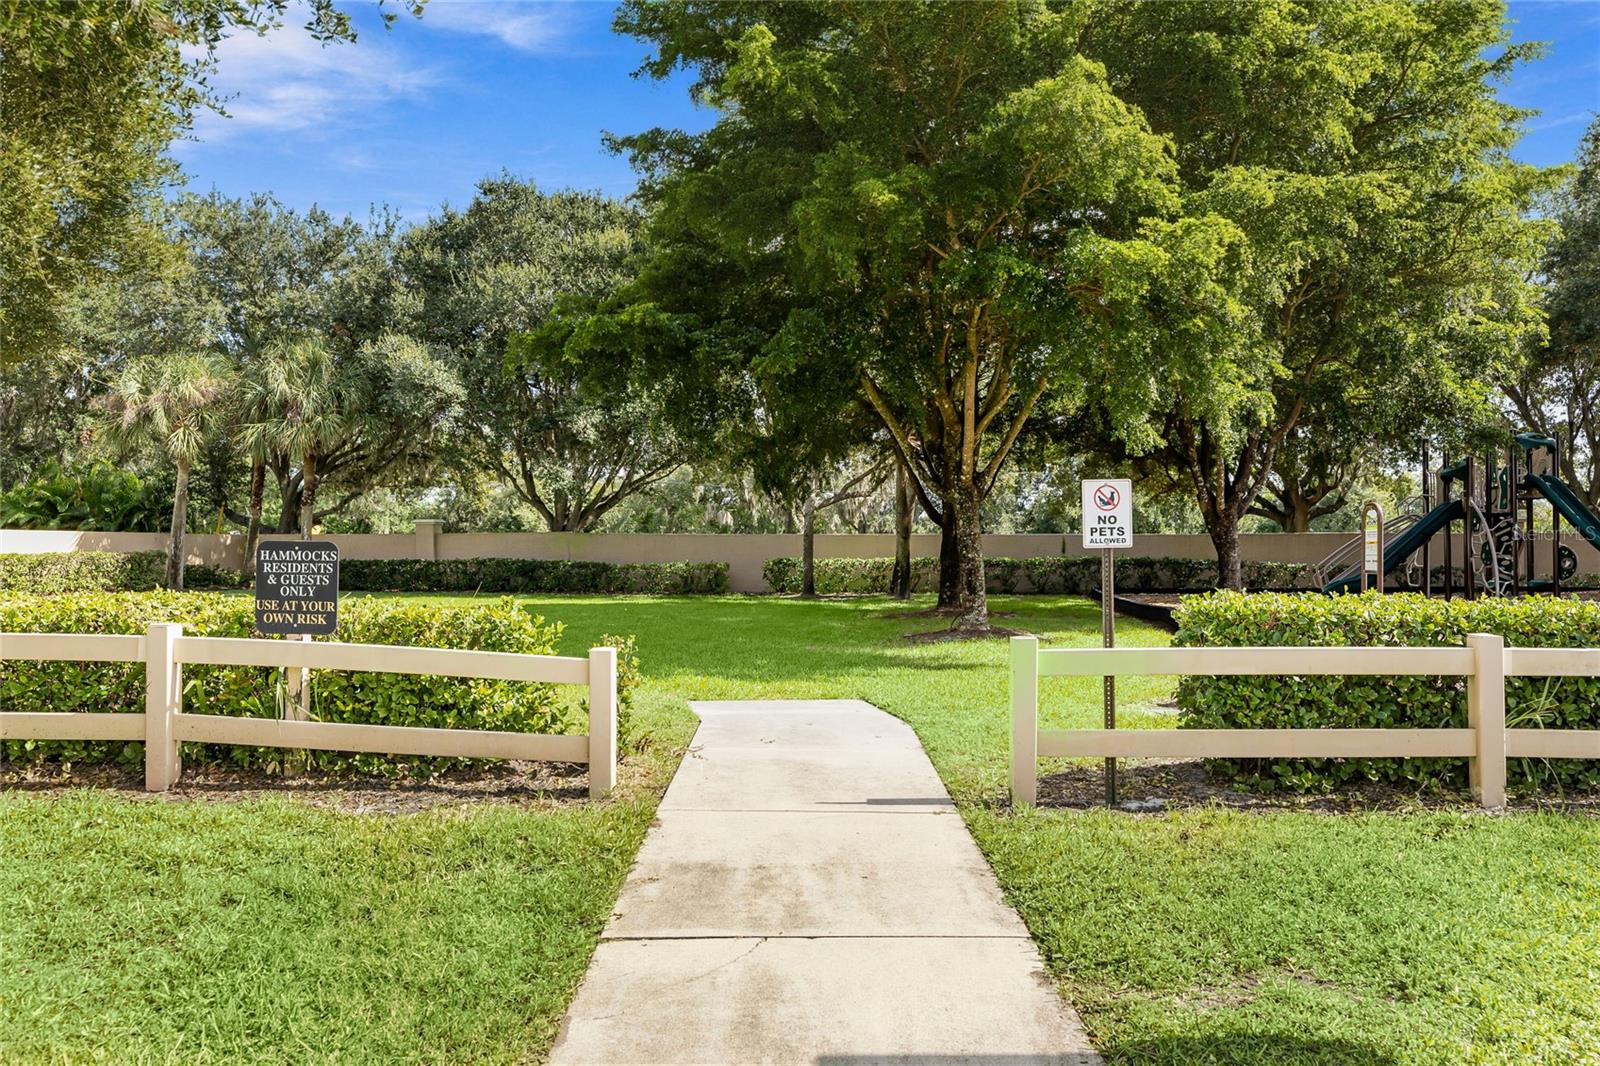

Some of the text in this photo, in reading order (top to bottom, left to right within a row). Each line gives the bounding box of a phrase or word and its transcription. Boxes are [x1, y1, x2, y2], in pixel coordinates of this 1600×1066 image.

[1097, 515, 1117, 524] NO
[1090, 527, 1125, 536] PETS
[260, 550, 337, 562] HAMMOCKS
[263, 562, 333, 574] RESIDENTS
[267, 574, 330, 586] & GUESTS
[280, 586, 316, 597] ONLY
[256, 599, 335, 612] USE AT YOUR
[263, 612, 327, 625] OWN RISK
